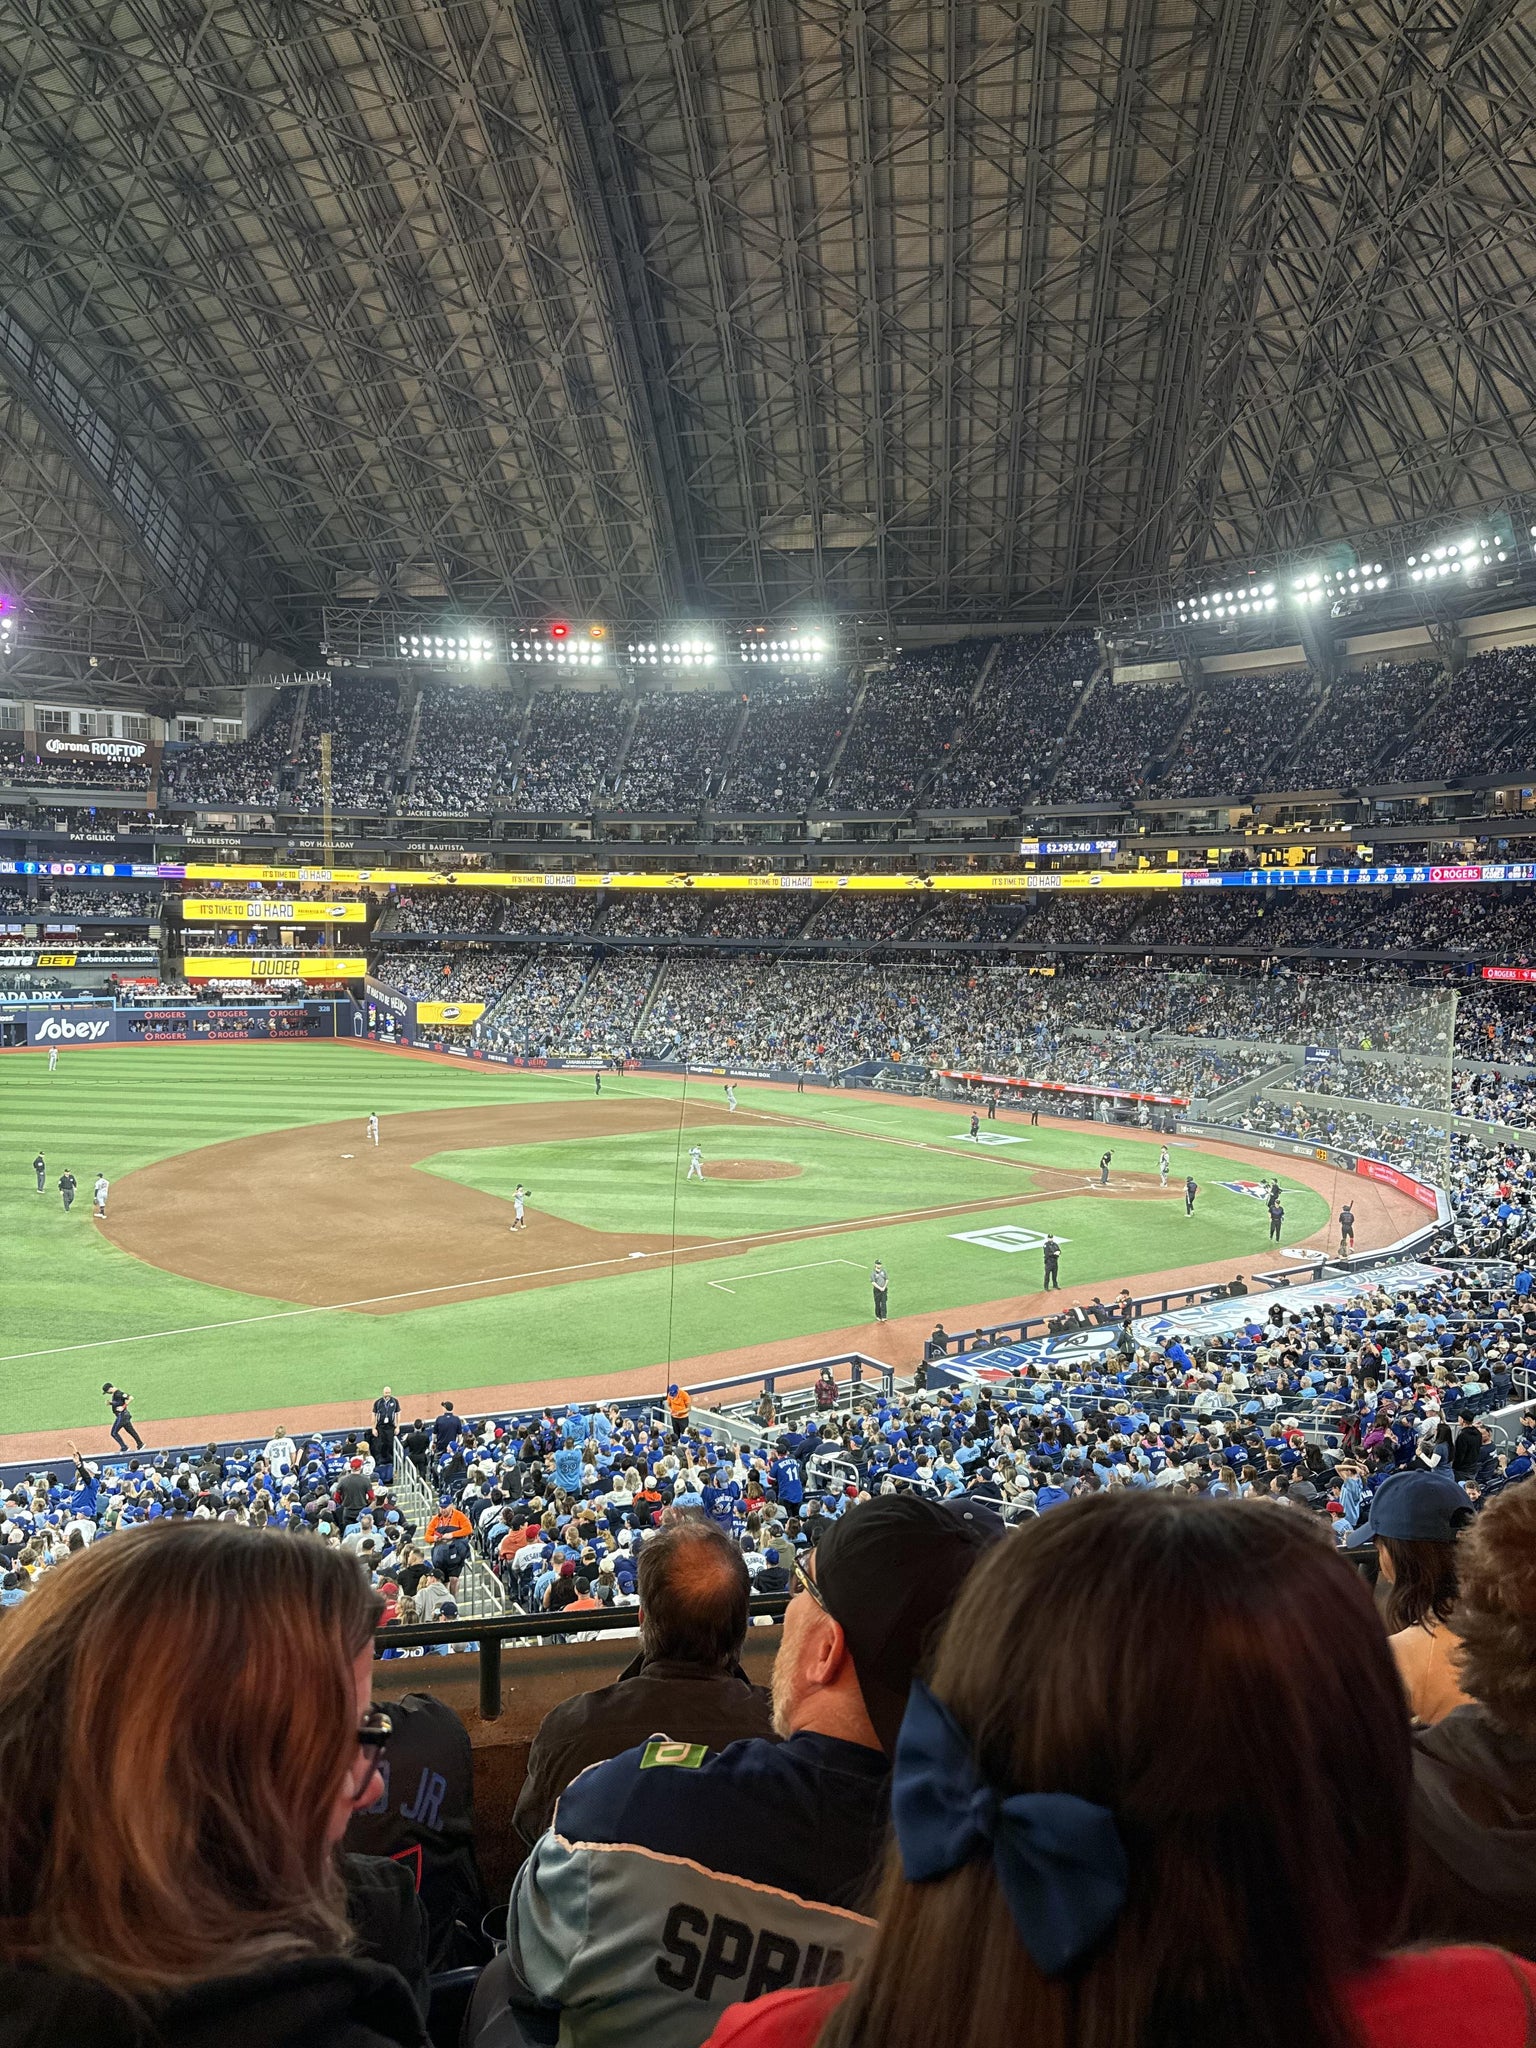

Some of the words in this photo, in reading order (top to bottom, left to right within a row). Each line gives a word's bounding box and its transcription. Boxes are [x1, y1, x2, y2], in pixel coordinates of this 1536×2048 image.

[46, 740, 90, 754] Corona
[91, 742, 146, 757] ROOFTOP
[70, 833, 84, 841] PAT
[86, 834, 116, 842] GILLICK
[298, 870, 308, 880] GO
[310, 870, 332, 880] HARD
[1443, 869, 1478, 879] ROGERS
[544, 875, 555, 884] GO
[556, 875, 576, 885] HARD
[780, 876, 790, 887] GO
[792, 877, 812, 887] HARD
[1027, 876, 1038, 887] GO
[1039, 876, 1061, 887] HARD
[200, 904, 213, 914] IT'S
[213, 905, 233, 915] TIME
[234, 905, 244, 915] TO
[247, 903, 261, 916] GO
[264, 904, 293, 917] HARD
[40, 956, 75, 965] BET
[251, 961, 300, 976] LOUDER
[390, 996, 408, 1017] HEINZ
[218, 1010, 248, 1018] ROGERS
[279, 1009, 308, 1017] ROGERS
[35, 1017, 110, 1040] Sobeys
[154, 1032, 186, 1040] ROGERS
[218, 1031, 248, 1039] ROGERS
[528, 1058, 548, 1067] HEINZ
[273, 1449, 287, 1458] 31
[561, 1462, 576, 1474] 39
[786, 1466, 799, 1481] 11
